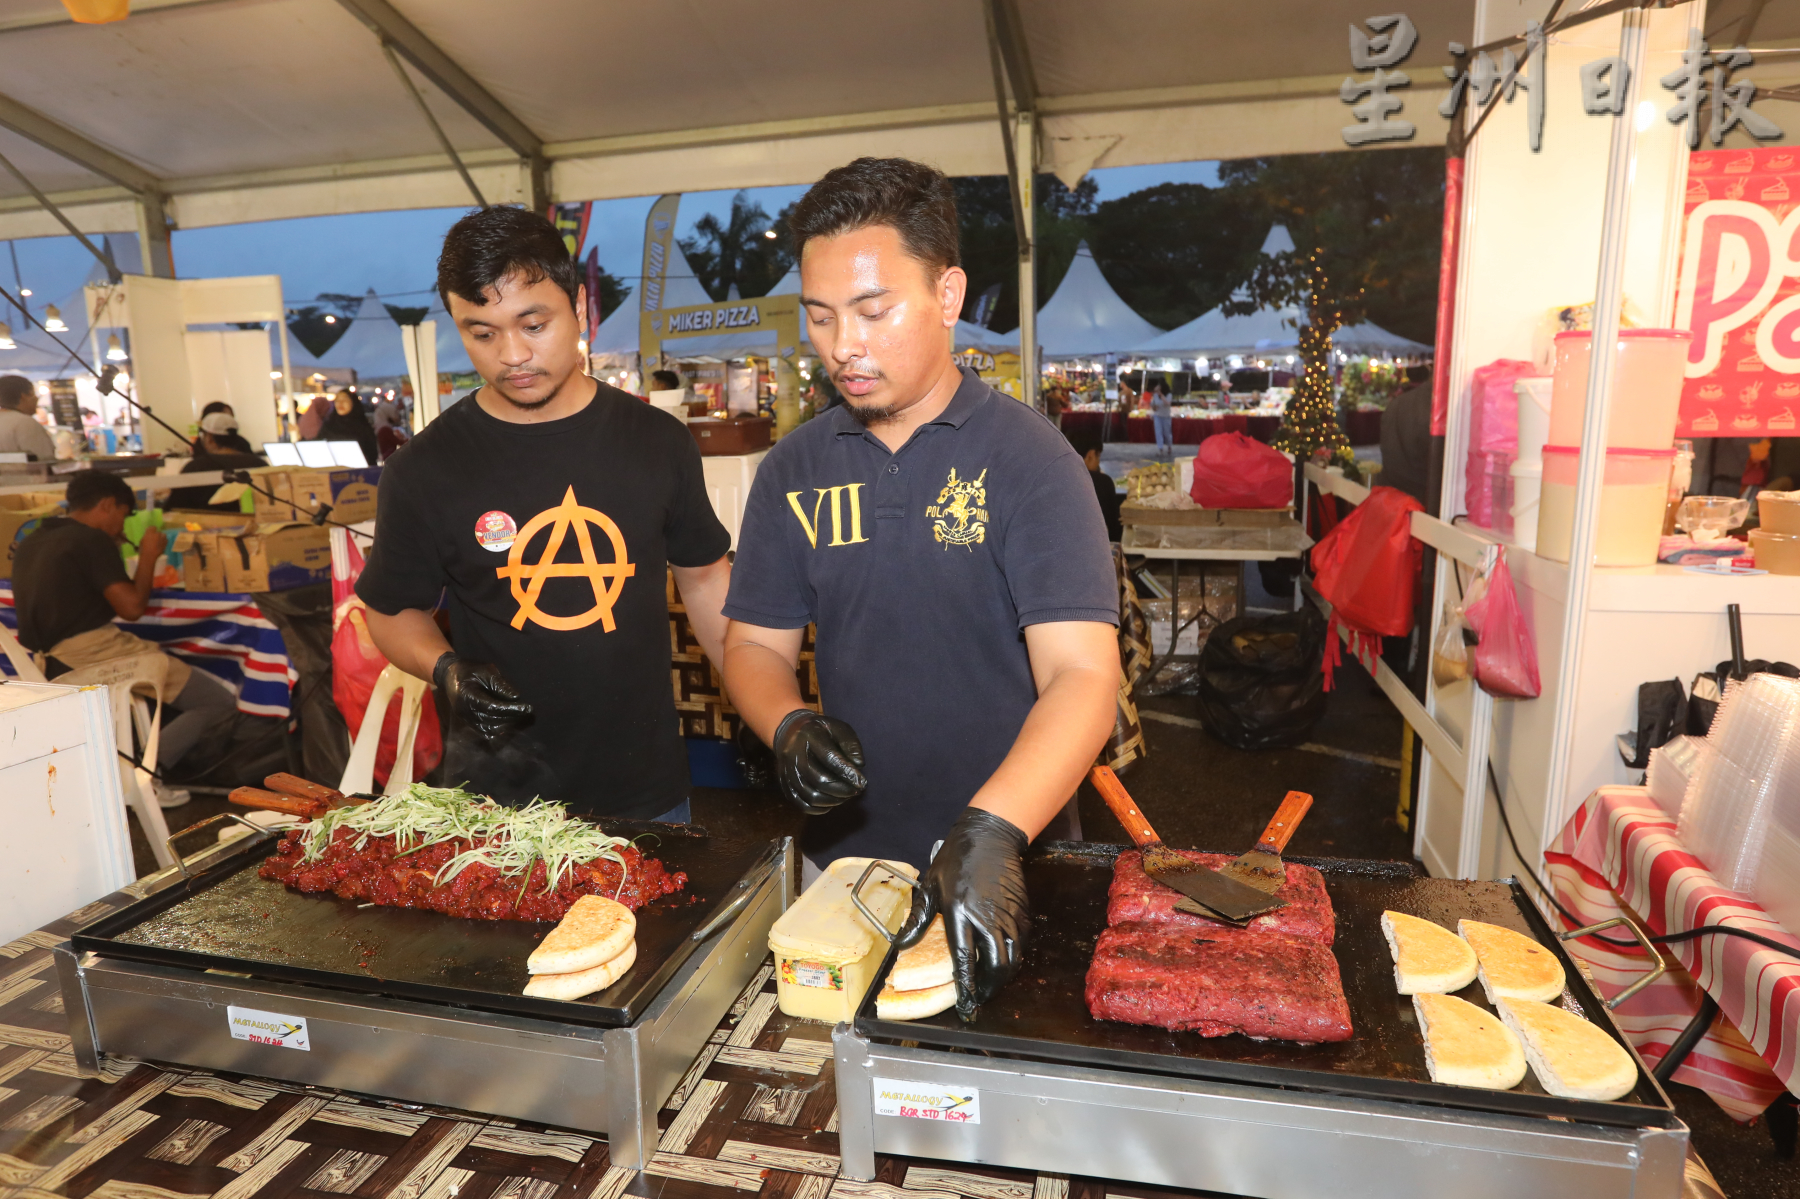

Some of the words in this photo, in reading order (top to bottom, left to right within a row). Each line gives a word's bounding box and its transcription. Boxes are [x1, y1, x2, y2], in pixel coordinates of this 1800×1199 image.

[669, 309, 714, 333] MIKER
[715, 305, 760, 329] PIZZA
[952, 353, 995, 371] PIZZA
[786, 483, 869, 549] VII
[484, 530, 511, 541] VENDOR
[921, 1109, 940, 1119] STD
[944, 1109, 968, 1123] 1624
